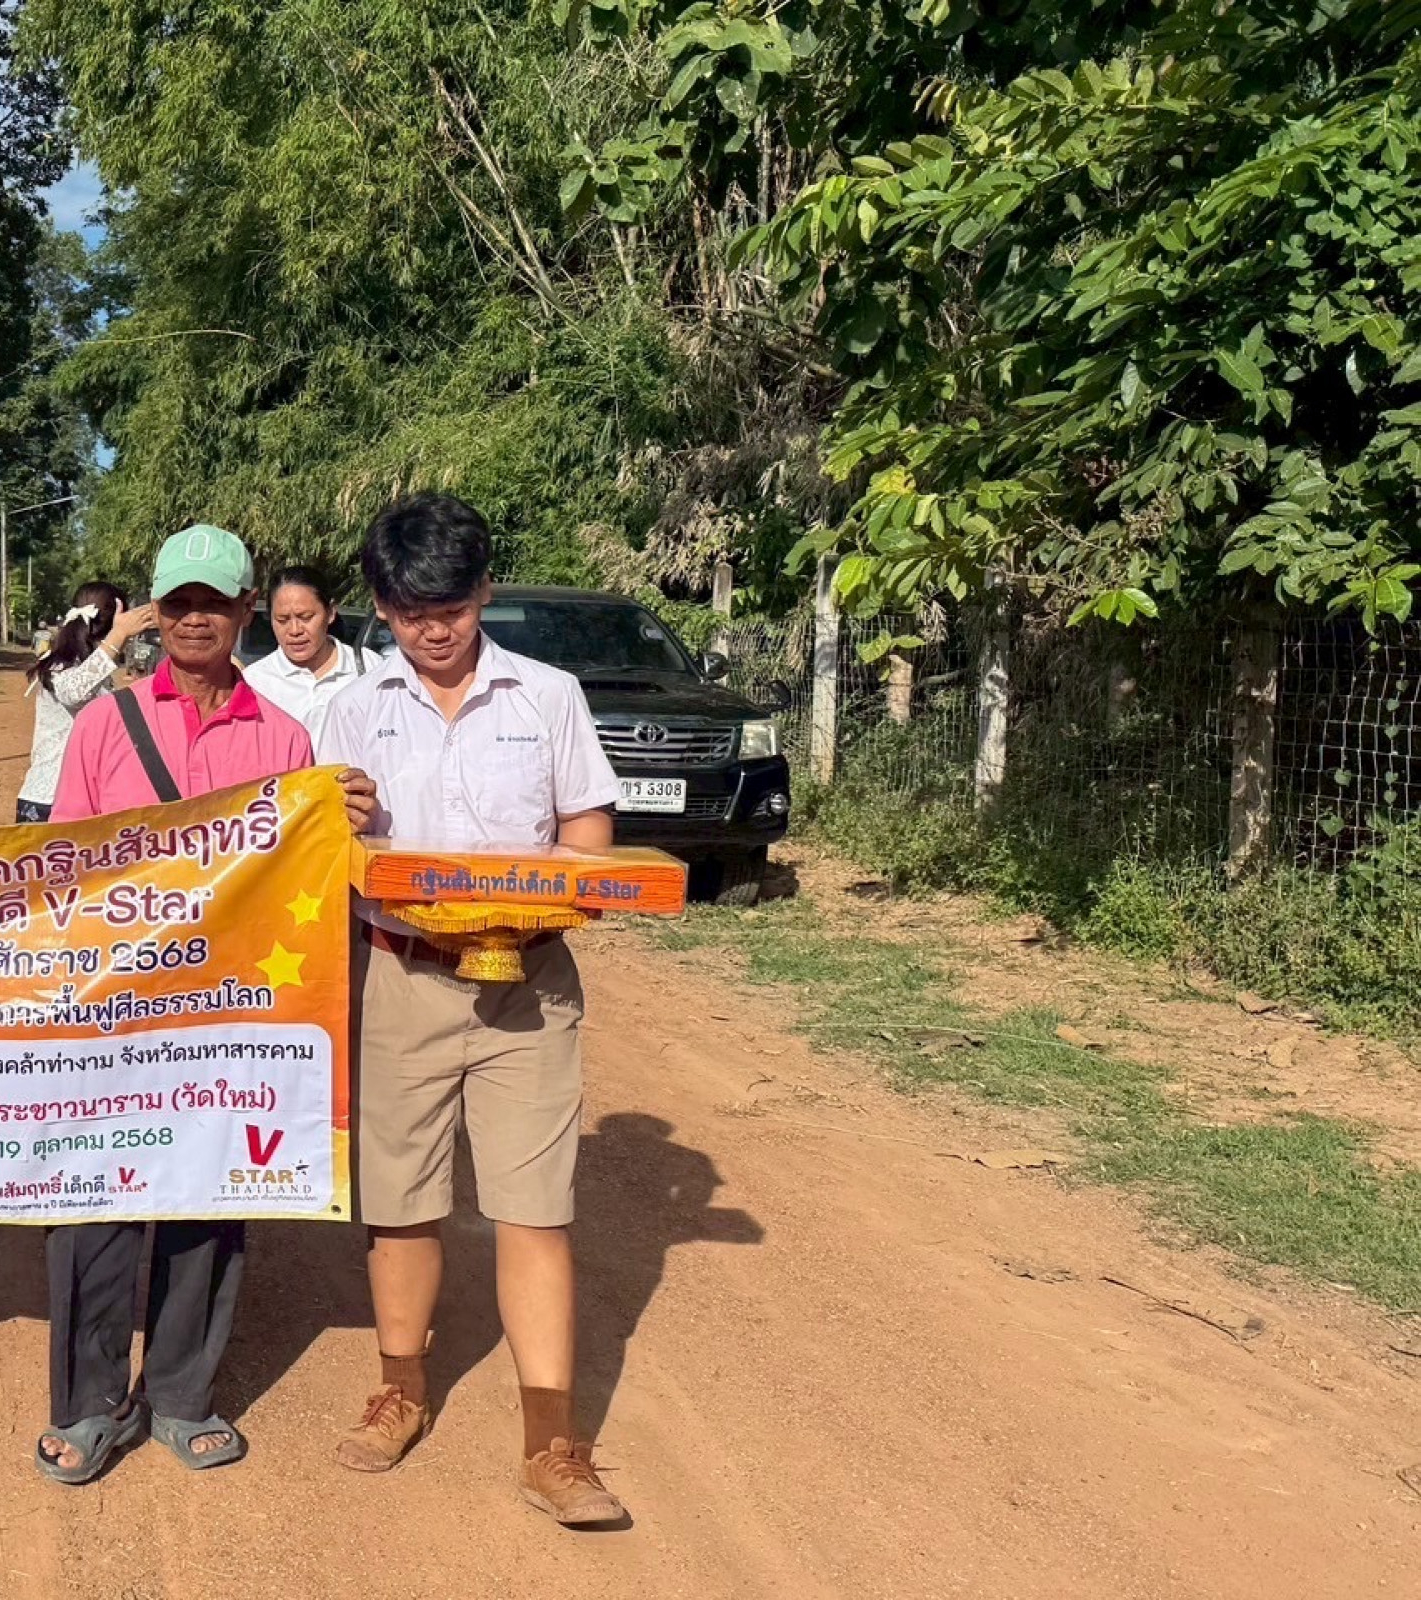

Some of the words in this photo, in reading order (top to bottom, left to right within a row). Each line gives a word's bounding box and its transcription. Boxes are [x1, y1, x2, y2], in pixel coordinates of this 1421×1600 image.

[576, 877, 642, 900] V-Star
[43, 884, 212, 933] V-Star
[109, 937, 208, 973] 2568
[120, 1041, 314, 1066] จังหวัดมหาสารคาม
[171, 1078, 277, 1112] (วัดใหม่)
[32, 1133, 105, 1161] ตุลาคม
[111, 1126, 174, 1149] 2568
[245, 1123, 285, 1166] V
[118, 1166, 136, 1185] V
[229, 1168, 294, 1184] STAR
[108, 1184, 143, 1194] STAR
[219, 1184, 313, 1195] THAILAND
